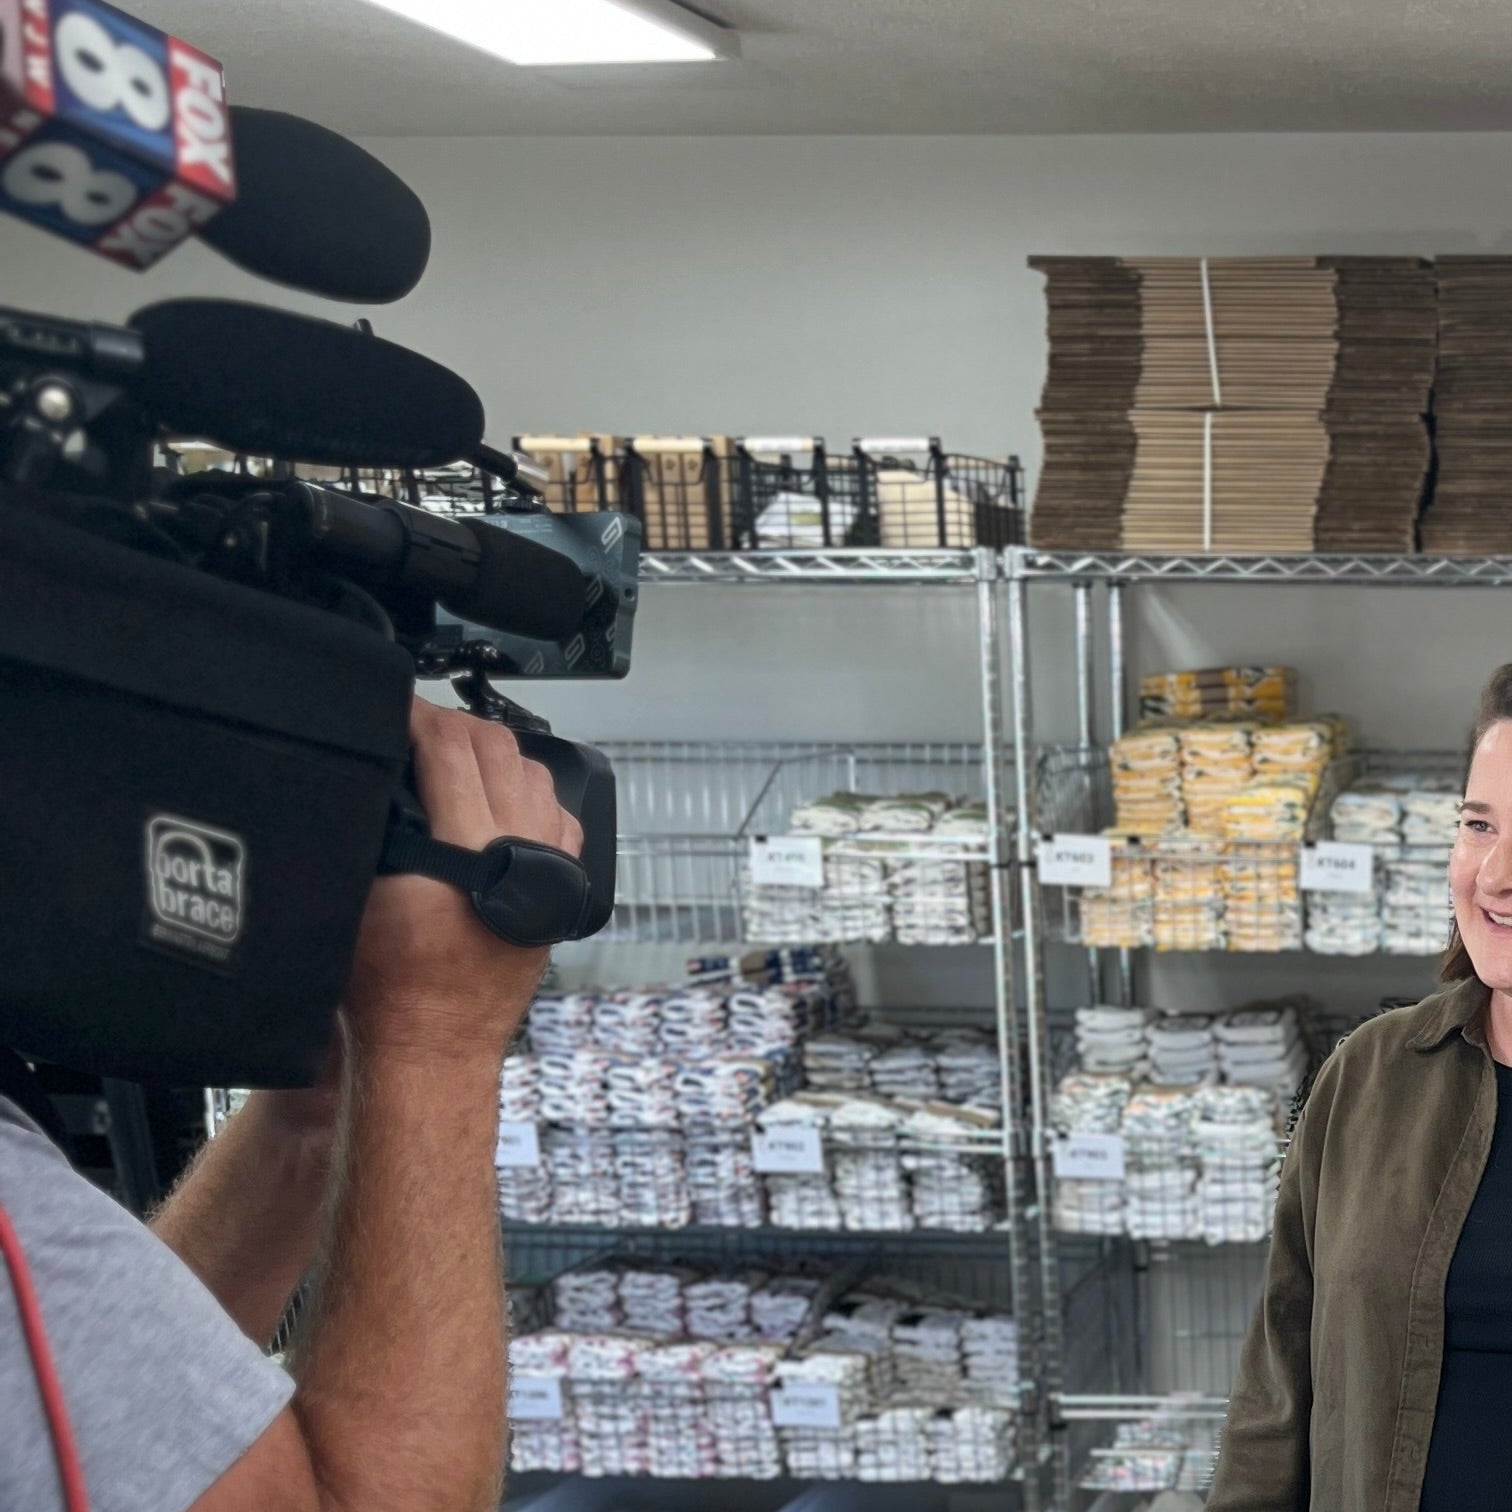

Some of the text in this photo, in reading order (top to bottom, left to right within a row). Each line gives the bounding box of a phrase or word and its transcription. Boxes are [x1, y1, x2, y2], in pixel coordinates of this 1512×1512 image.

[55, 12, 170, 131] 8
[169, 49, 232, 186] FOX
[4, 142, 138, 225] 8
[98, 182, 220, 268] FOX
[157, 848, 233, 897] porta
[158, 878, 233, 933] brace
